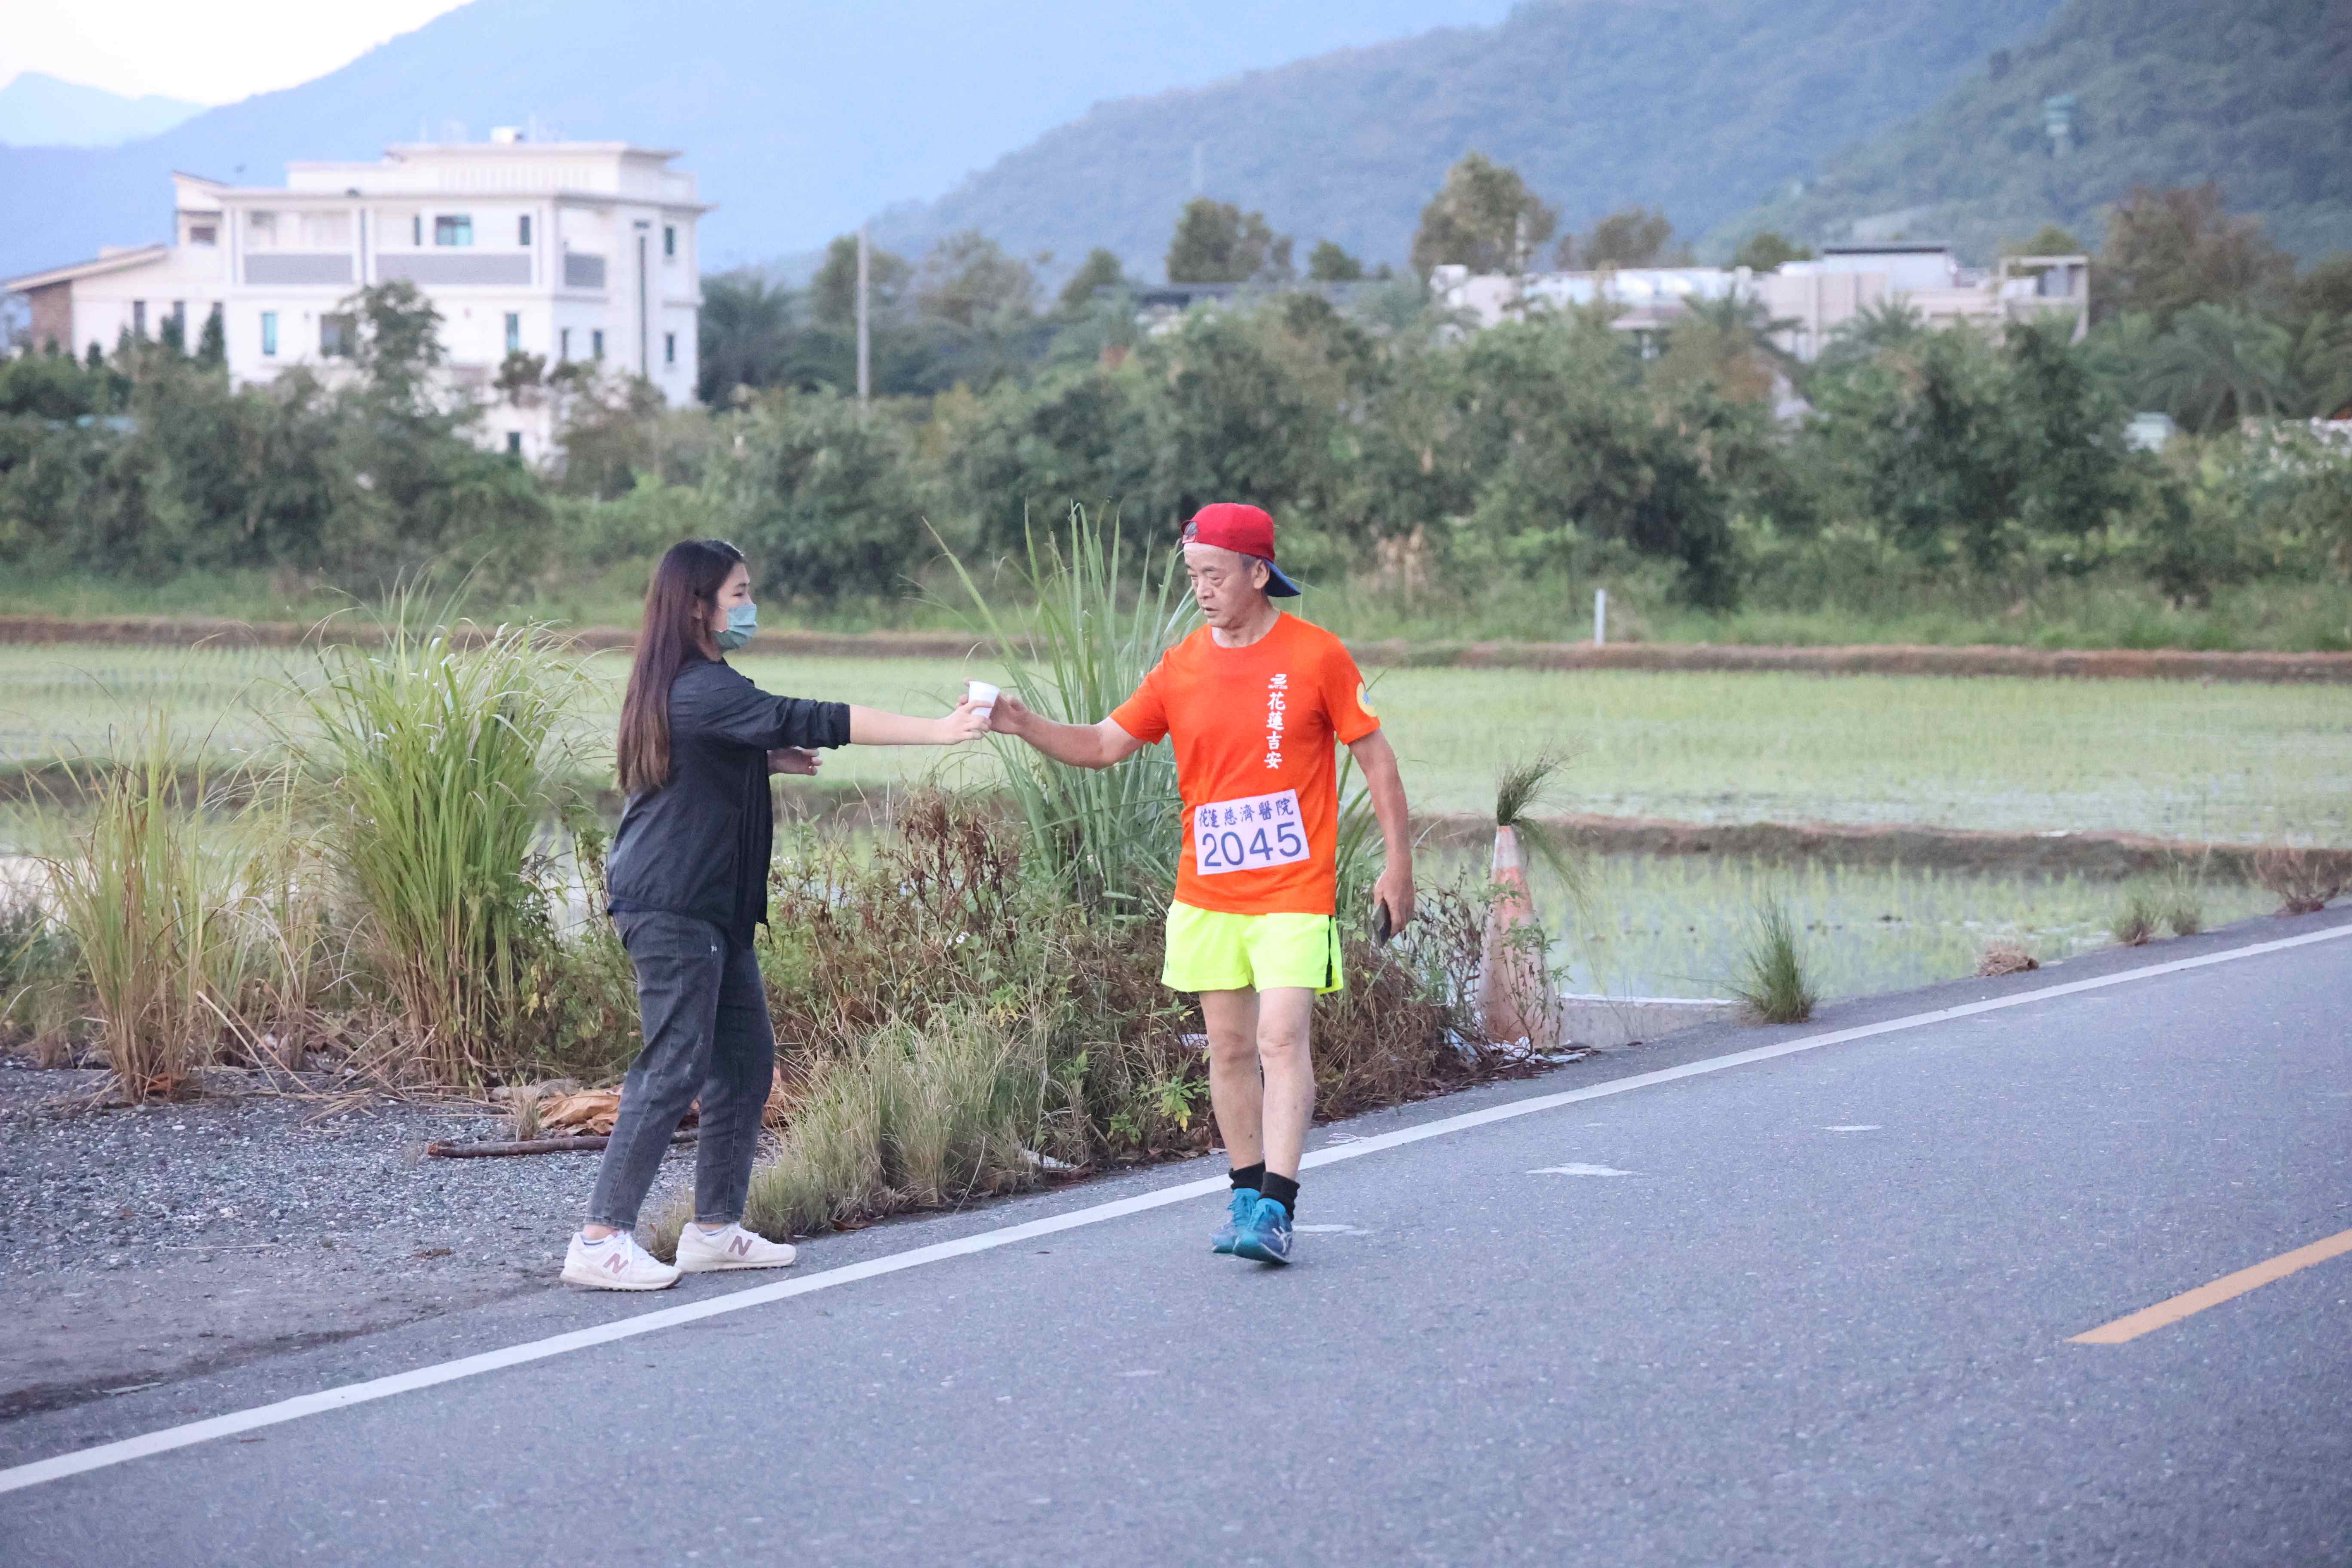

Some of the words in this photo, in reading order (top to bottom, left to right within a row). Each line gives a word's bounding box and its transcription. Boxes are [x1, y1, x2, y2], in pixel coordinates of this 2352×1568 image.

[1263, 691, 1286, 769] 花蓮吉安
[1199, 798, 1293, 828] 花蓮慈濟醫院
[1202, 821, 1302, 867] 2045
[728, 1235, 753, 1256] N
[603, 1253, 628, 1274] N
